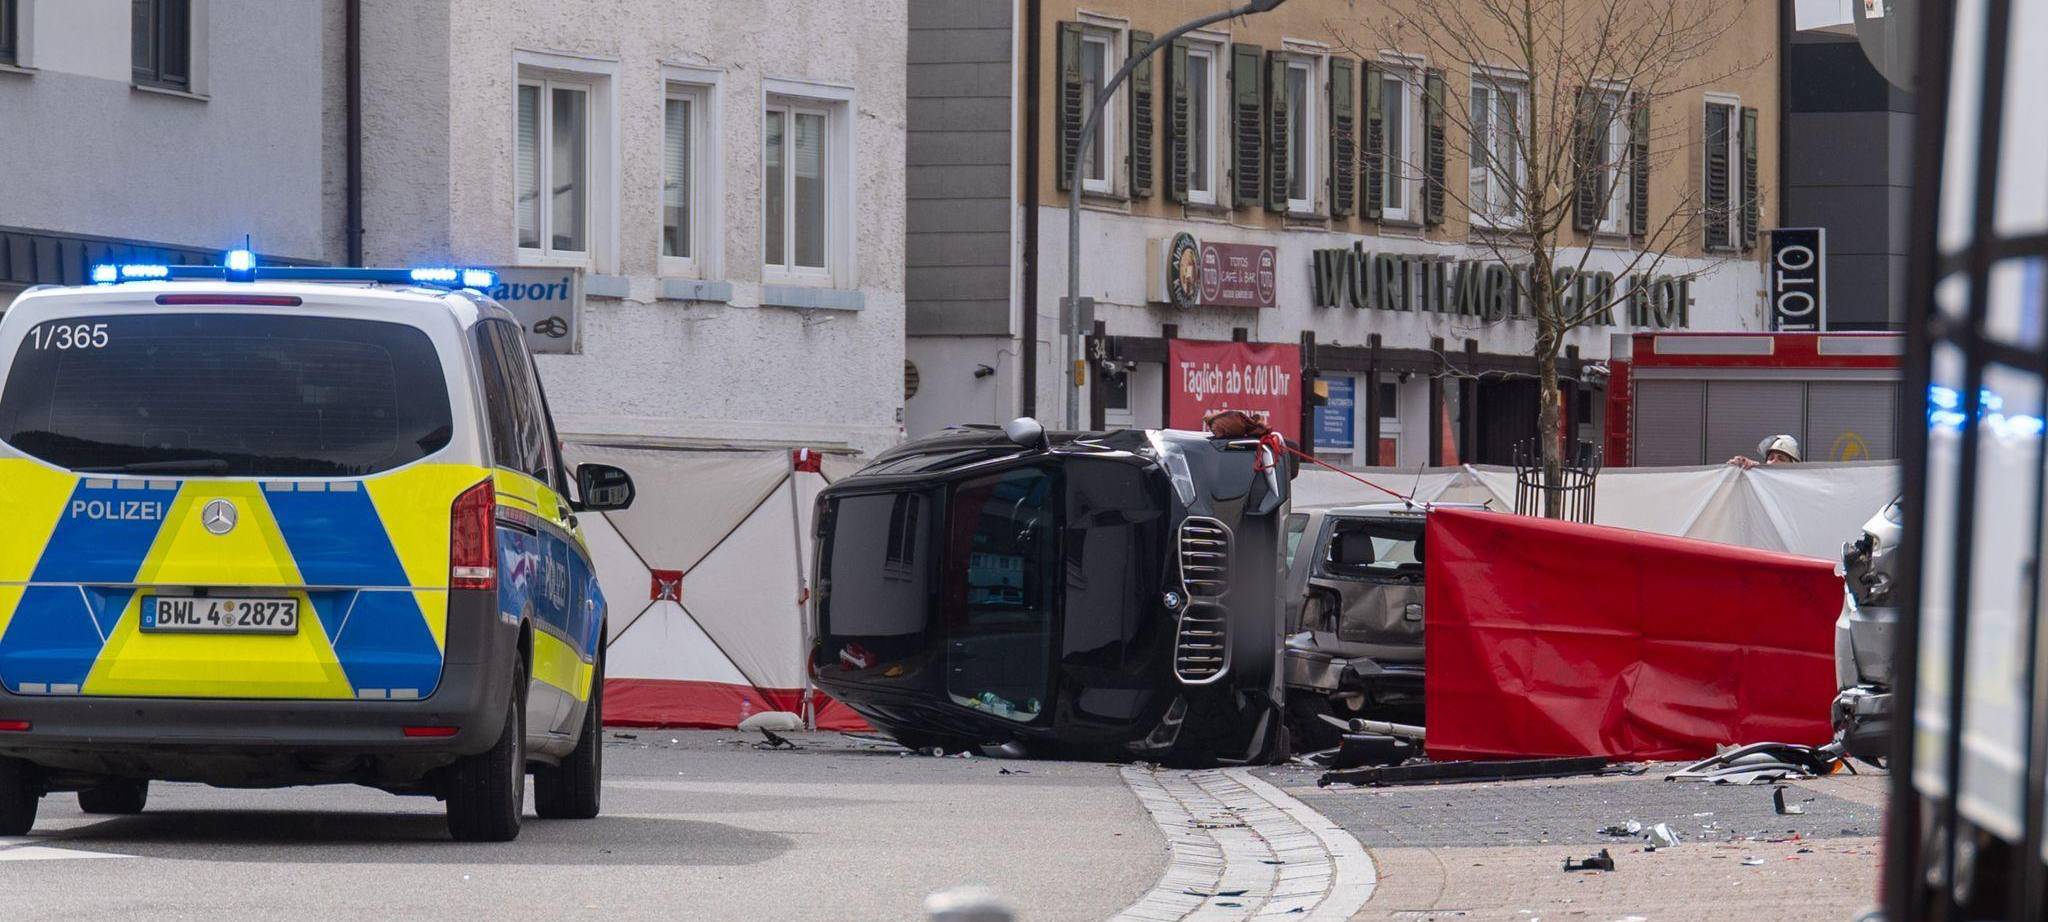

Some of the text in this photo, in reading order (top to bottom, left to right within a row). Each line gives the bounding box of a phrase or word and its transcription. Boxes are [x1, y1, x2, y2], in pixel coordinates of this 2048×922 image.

[491, 276, 569, 301] avori
[1630, 273, 1696, 328] HOF
[30, 323, 109, 350] 1/365
[1093, 339, 1107, 360] 34
[1180, 361, 1291, 401] Täglich ab 6.00 Uhr
[71, 499, 162, 520] POLIZEI
[158, 600, 295, 626] BWL 4 2873
